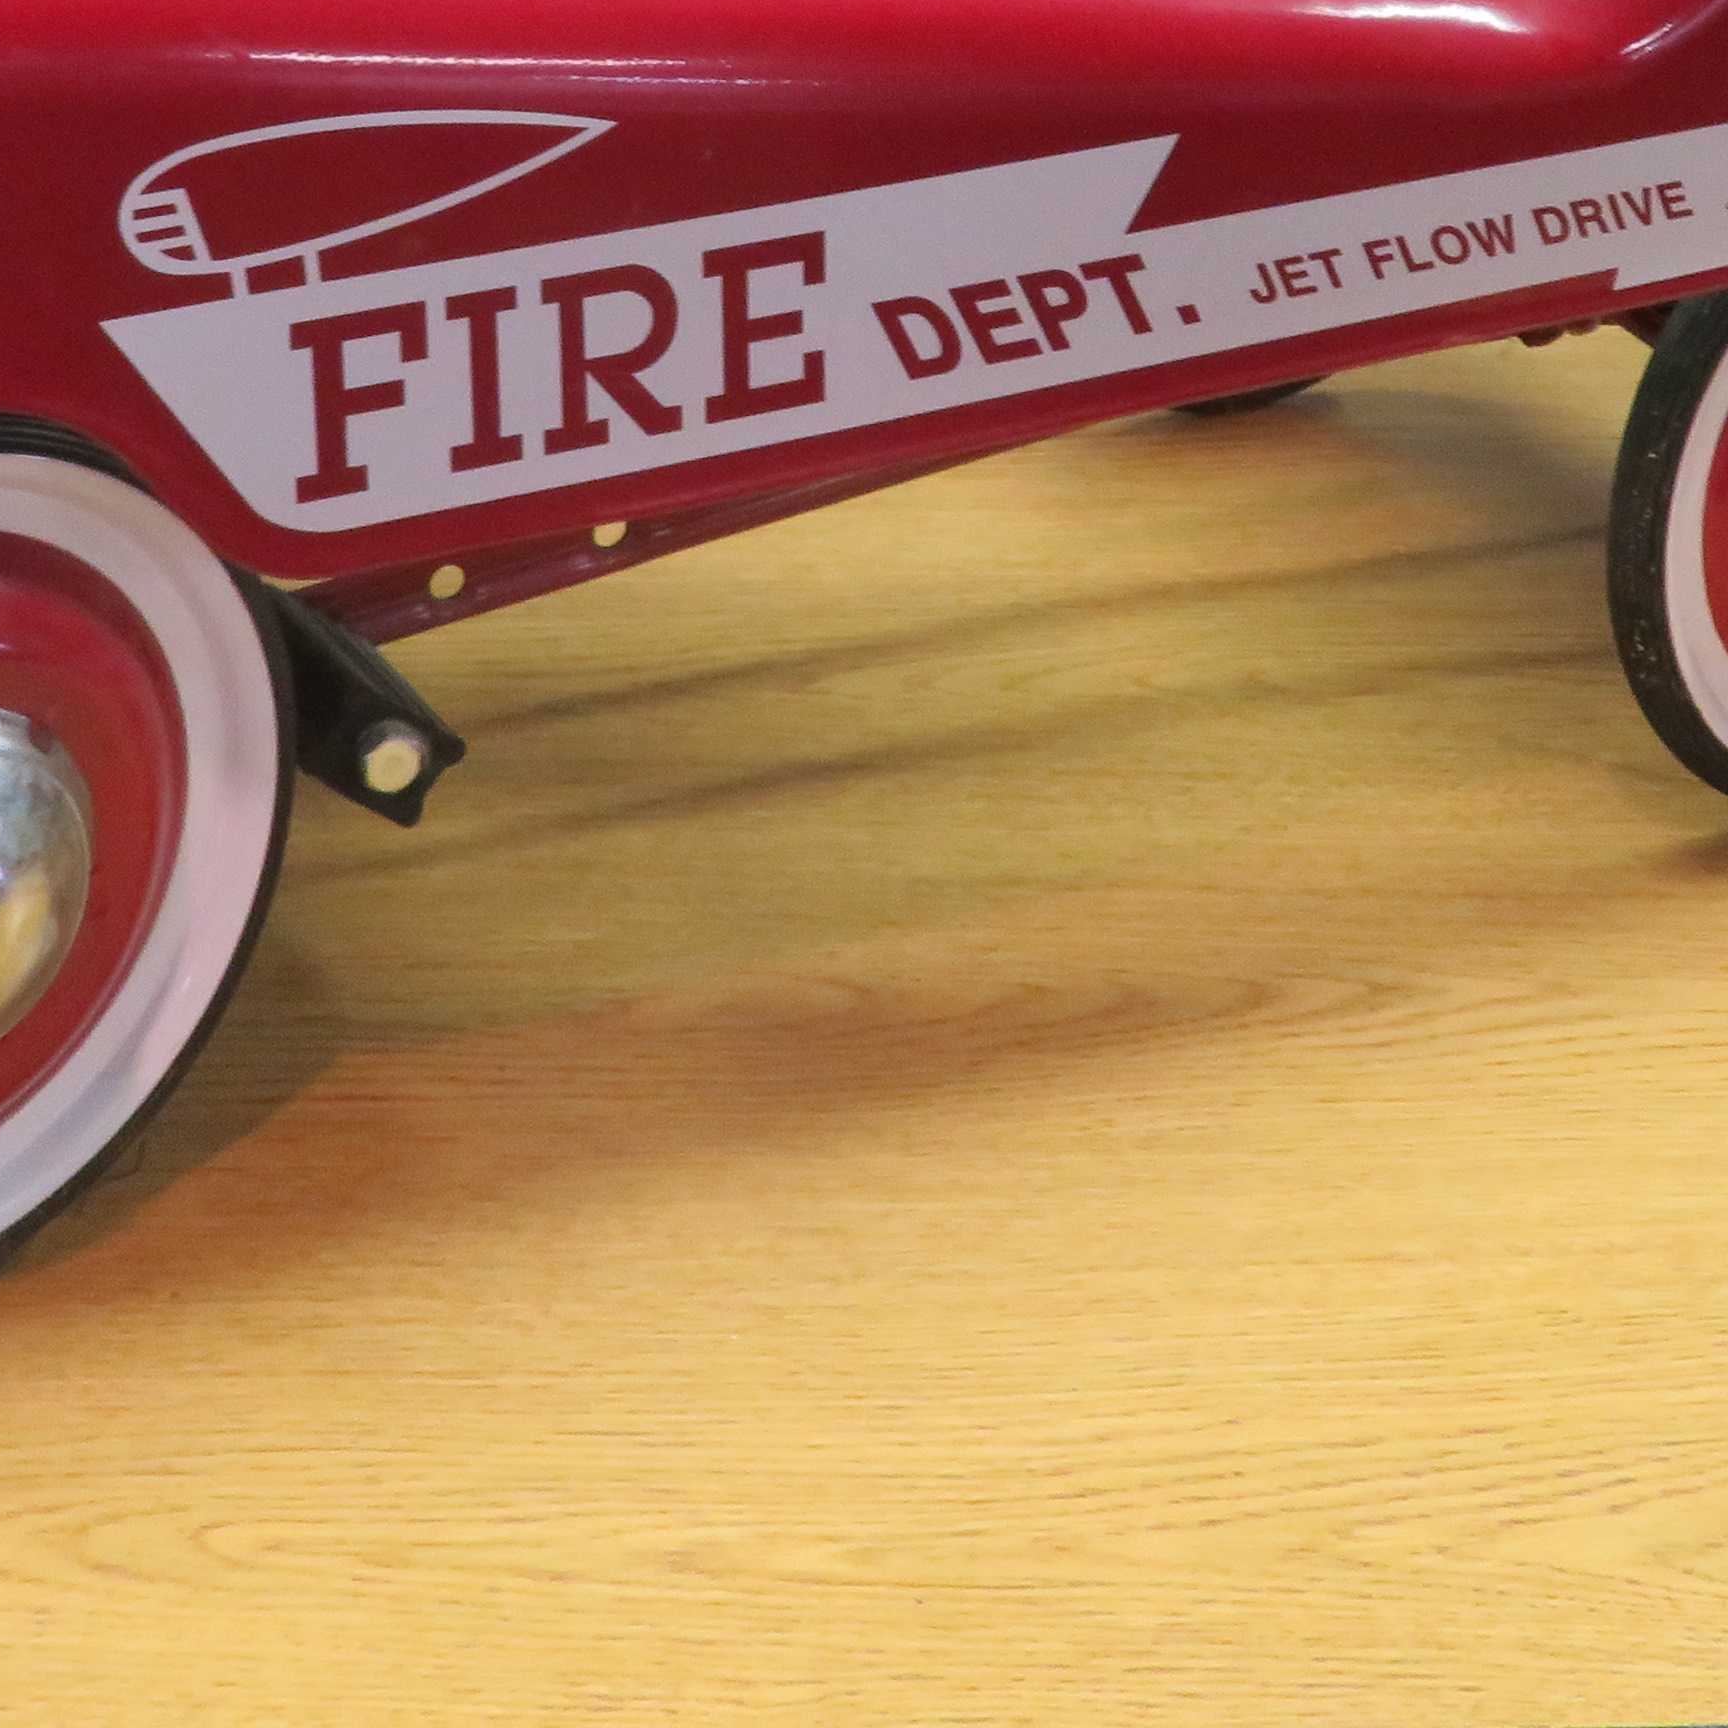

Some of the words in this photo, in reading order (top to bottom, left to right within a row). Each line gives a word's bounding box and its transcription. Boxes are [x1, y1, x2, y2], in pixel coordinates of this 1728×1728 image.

[289, 230, 828, 505] FIRE
[871, 254, 1202, 382] DEPT.
[1249, 247, 1345, 305] JET
[1361, 213, 1518, 280] FLOW
[1531, 181, 1694, 246] DRIVE
